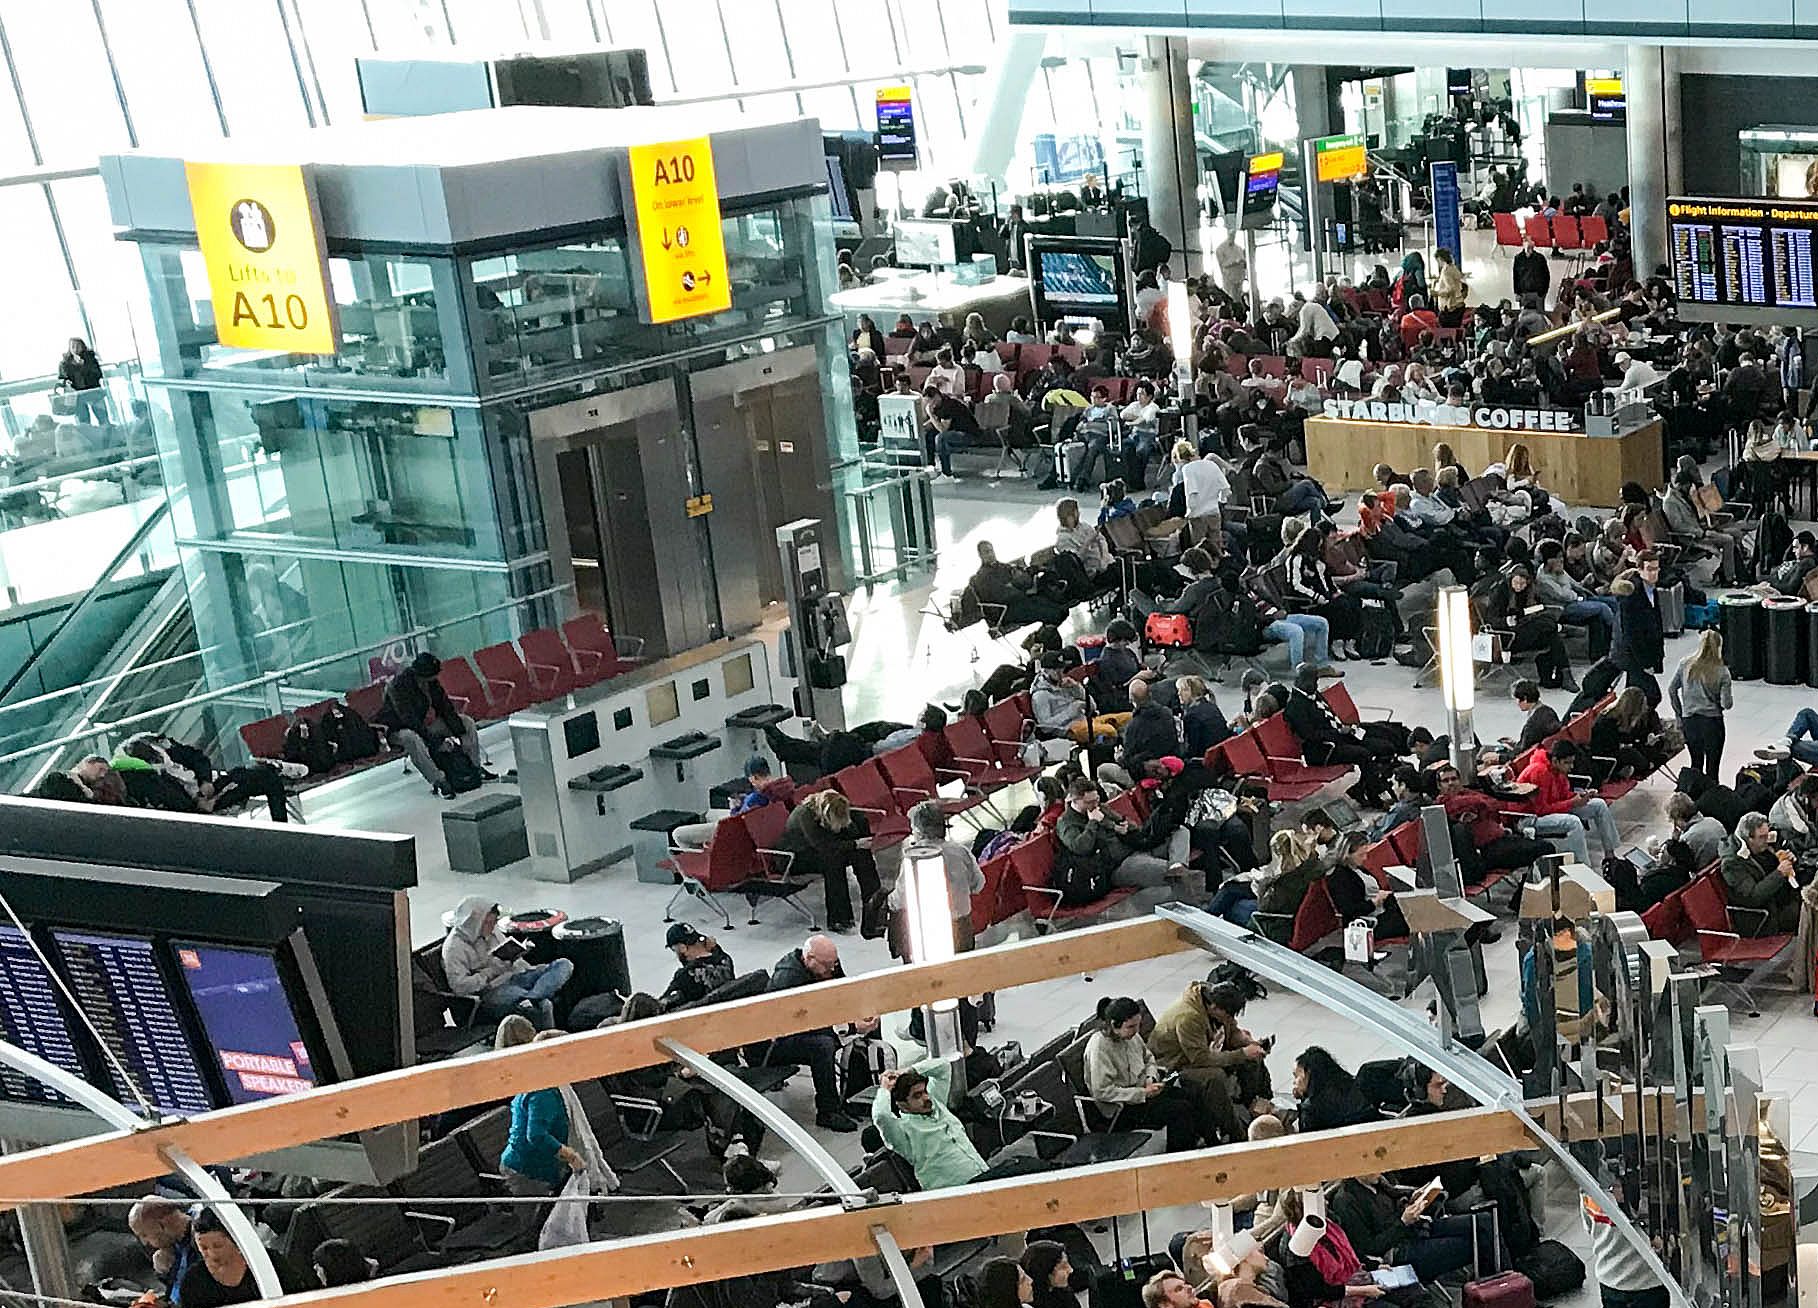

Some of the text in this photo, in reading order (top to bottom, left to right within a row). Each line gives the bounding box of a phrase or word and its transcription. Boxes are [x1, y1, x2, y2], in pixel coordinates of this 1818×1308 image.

[655, 155, 695, 186] A10
[1681, 205, 1708, 217] Flight
[1708, 206, 1764, 217] Information
[233, 291, 308, 330] A10
[1475, 407, 1571, 432] COFFEE
[224, 1054, 296, 1074] PORTABLE
[242, 1076, 313, 1094] SPEAKERS
